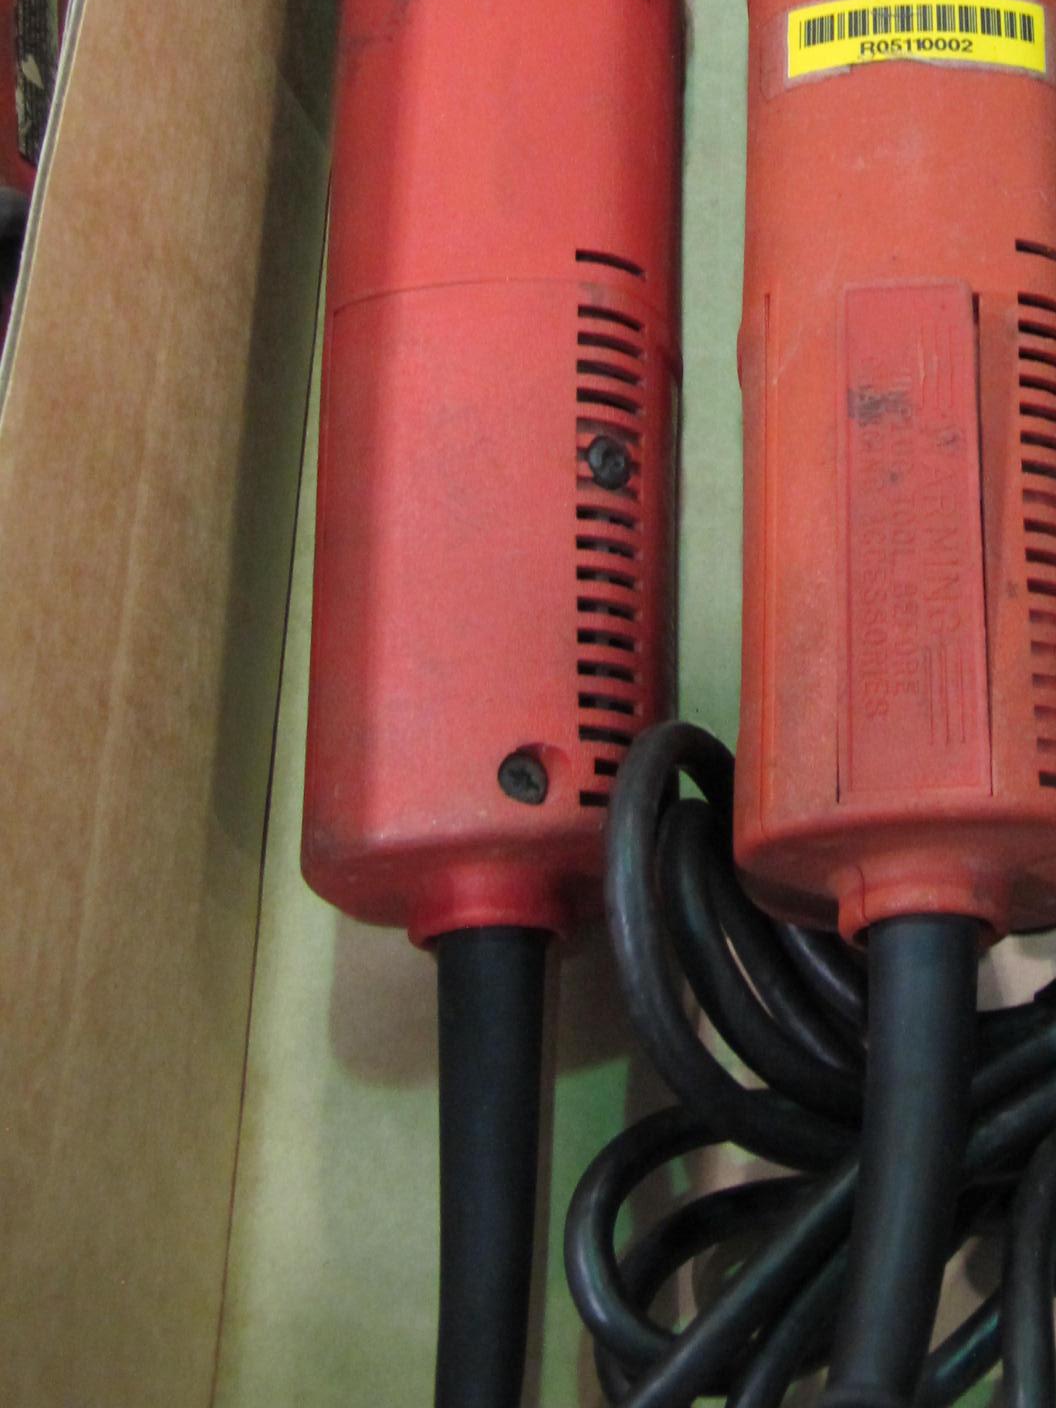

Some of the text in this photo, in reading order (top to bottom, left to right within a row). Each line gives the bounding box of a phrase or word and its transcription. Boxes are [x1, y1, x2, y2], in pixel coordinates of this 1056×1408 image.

[859, 39, 973, 56] R05110002
[921, 424, 963, 635] WARNING
[859, 511, 889, 721] ACCESSORIES
[891, 584, 920, 697] BEFORE
